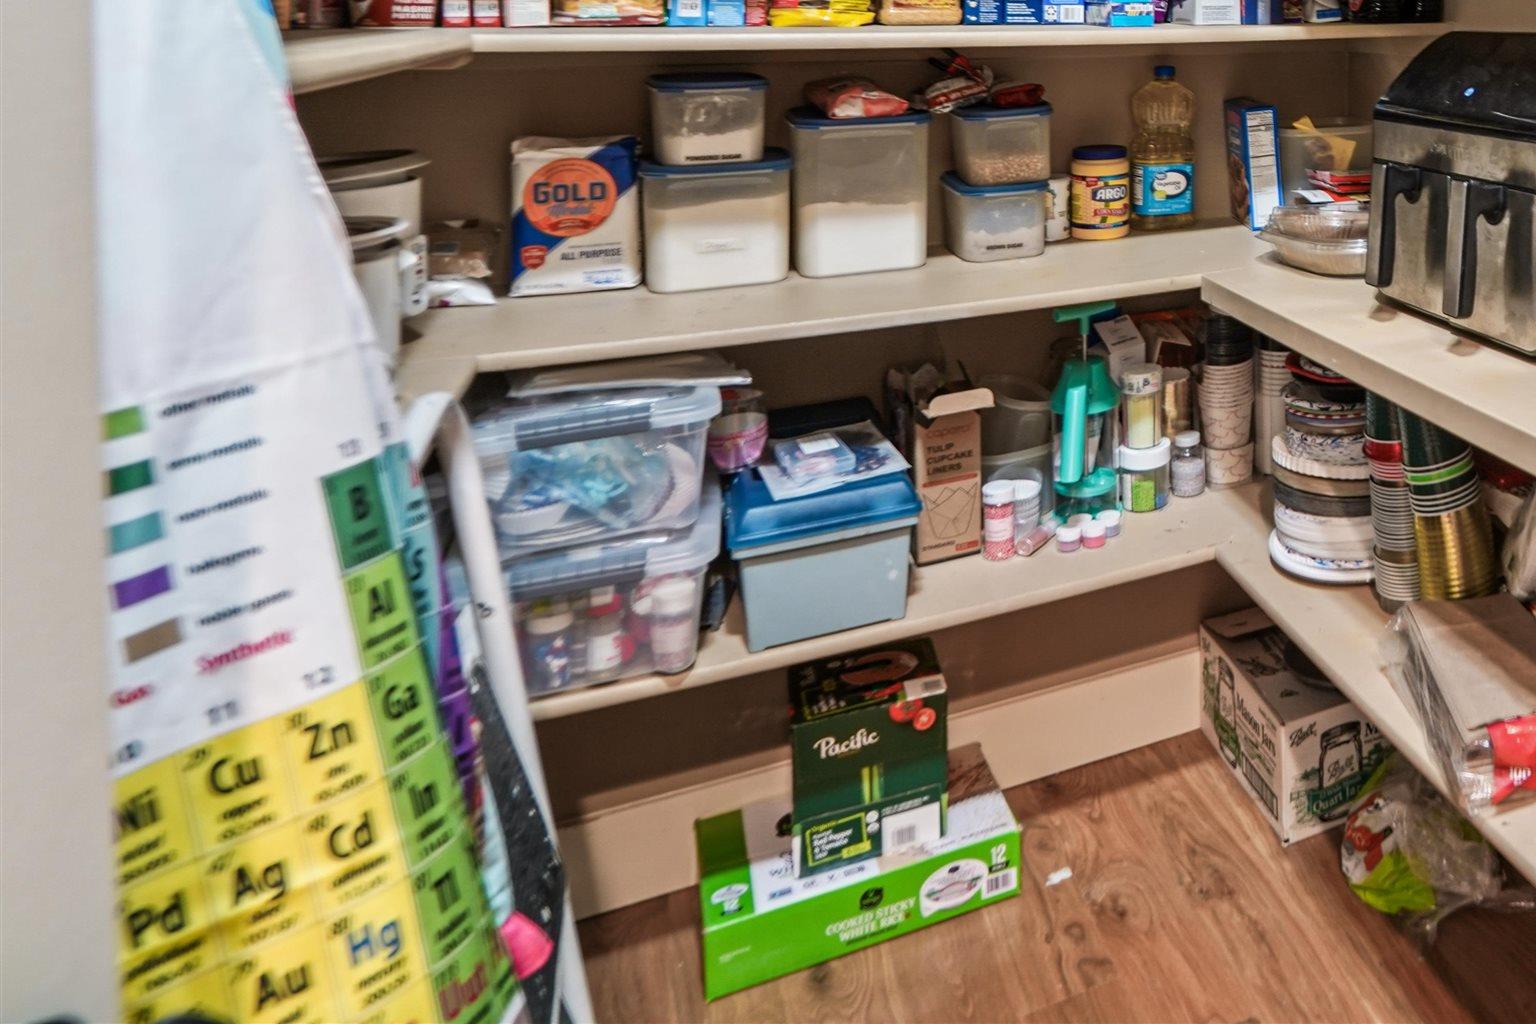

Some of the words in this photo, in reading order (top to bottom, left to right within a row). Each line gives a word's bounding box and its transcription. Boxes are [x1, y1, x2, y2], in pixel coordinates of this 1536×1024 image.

[533, 182, 607, 205] GOLD
[1094, 184, 1128, 201] ARGO
[928, 442, 955, 453] TULIP
[347, 484, 371, 523] B
[367, 578, 397, 623] Al
[383, 685, 419, 721] Ga
[303, 722, 356, 762] Zn
[813, 728, 879, 759] Pacific
[1289, 721, 1318, 749] Ball
[208, 755, 262, 796] Cu
[1312, 787, 1344, 815] Quart
[328, 809, 376, 858] Cd
[990, 842, 1006, 862] 12
[233, 860, 286, 906] Ag
[127, 890, 186, 949] Pd
[348, 919, 402, 968] Hg
[255, 966, 309, 1013] Au
